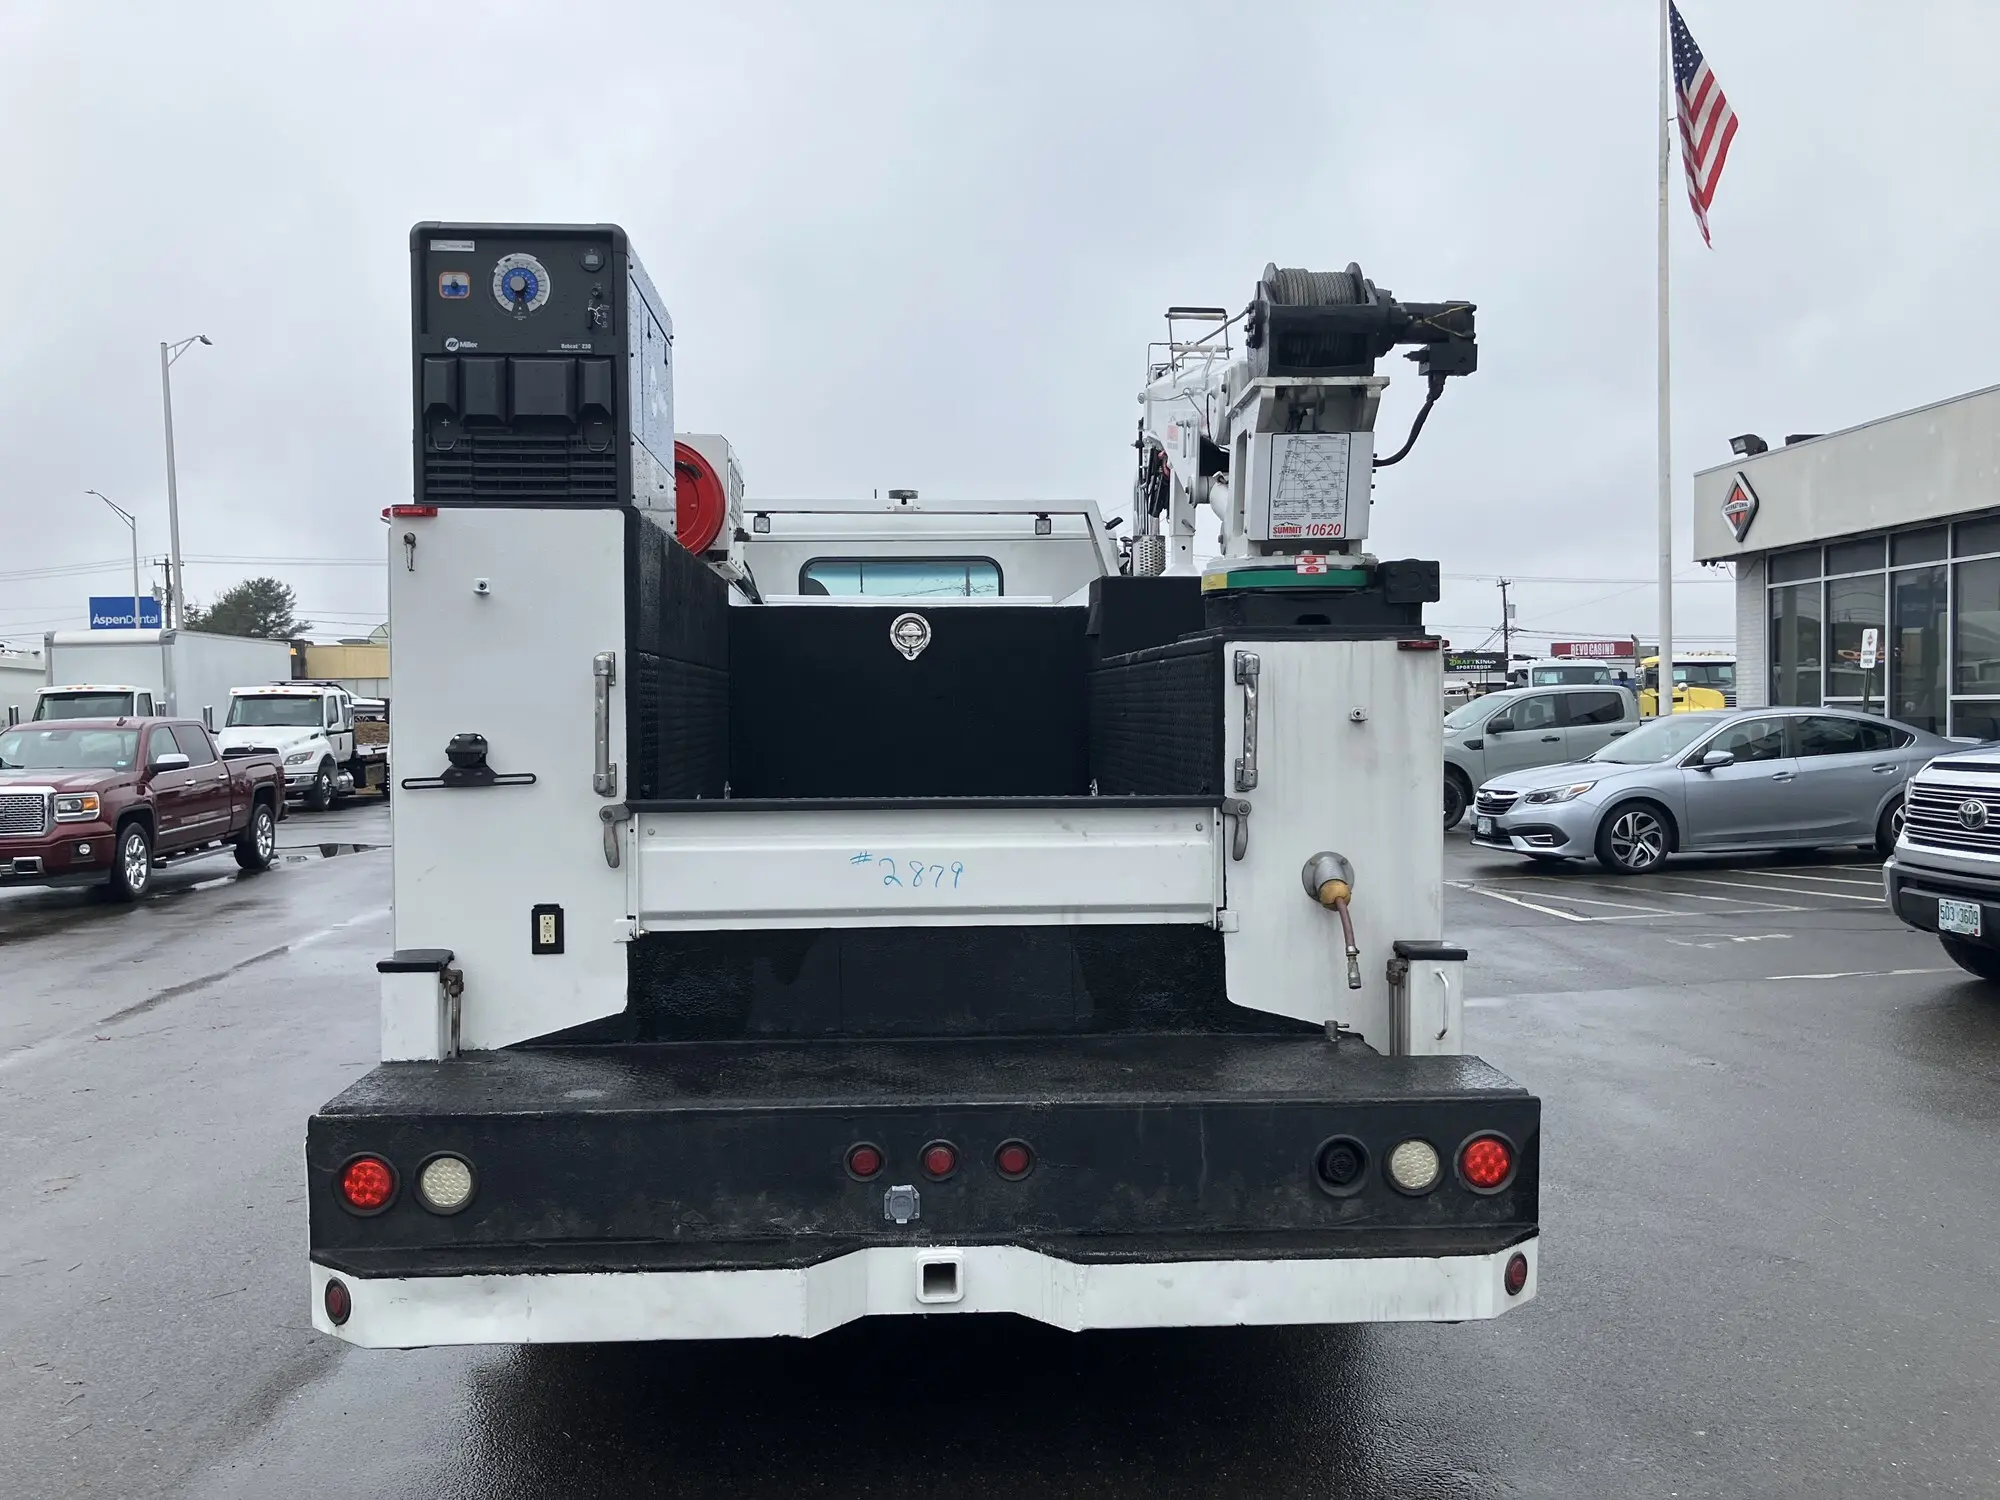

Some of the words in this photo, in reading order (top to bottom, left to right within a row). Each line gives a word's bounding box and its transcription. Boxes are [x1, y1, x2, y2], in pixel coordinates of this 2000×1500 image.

[460, 341, 478, 349] Miller
[1273, 526, 1302, 534] SUMMIT
[1306, 523, 1341, 536] 10620
[1589, 643, 1615, 655] CASINO
[1940, 904, 1954, 921] 503
[1960, 908, 1979, 926] 3609
